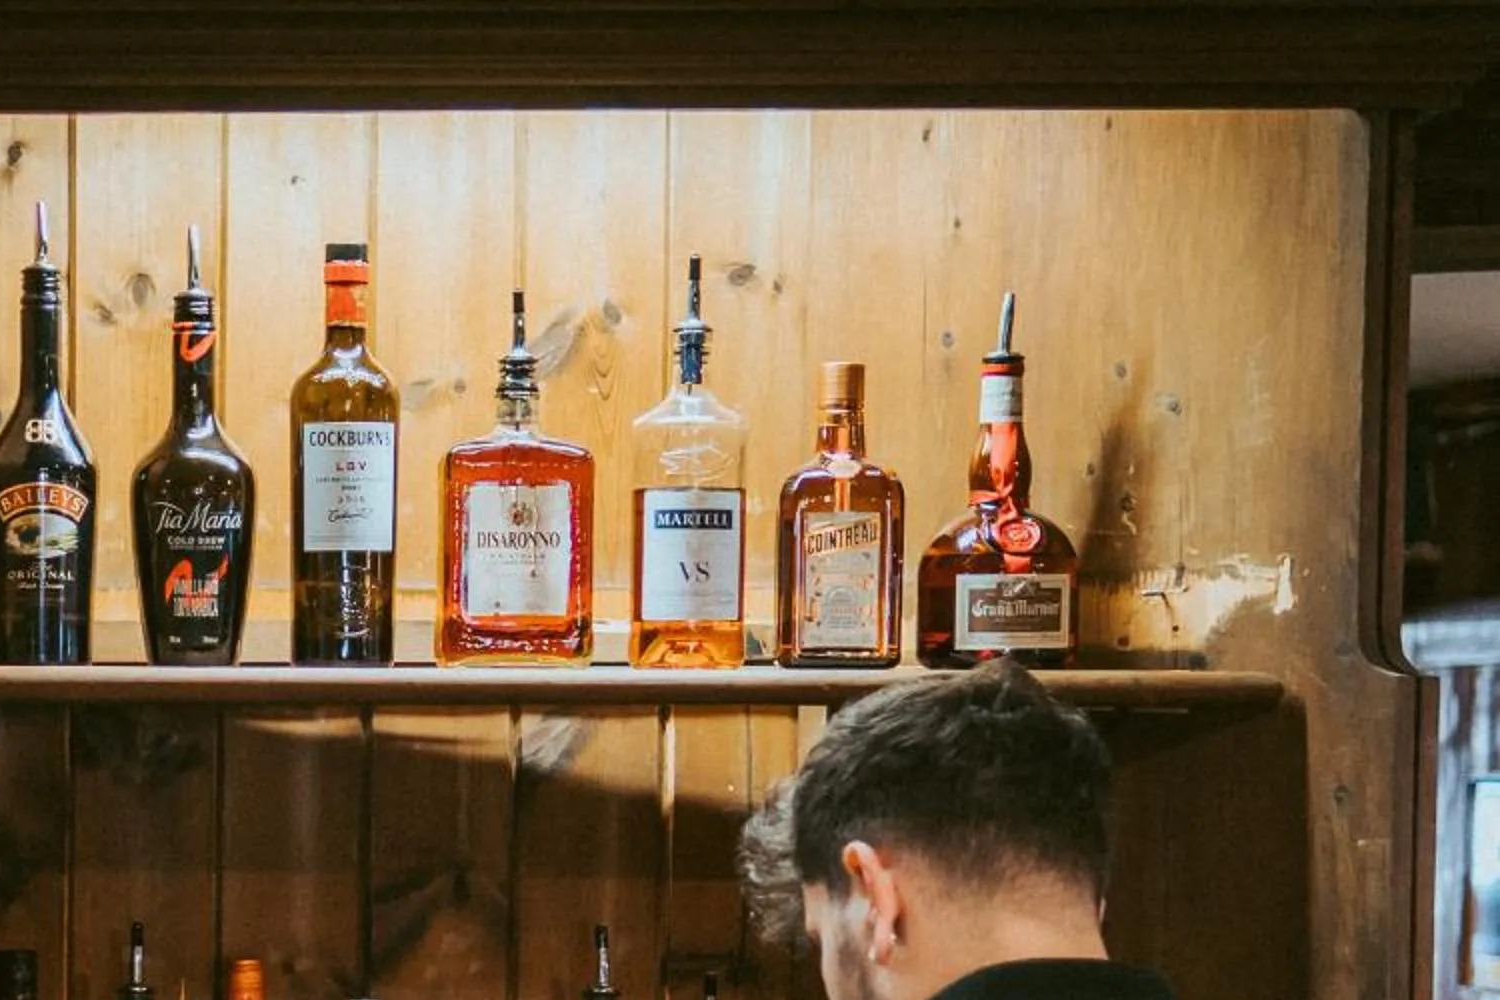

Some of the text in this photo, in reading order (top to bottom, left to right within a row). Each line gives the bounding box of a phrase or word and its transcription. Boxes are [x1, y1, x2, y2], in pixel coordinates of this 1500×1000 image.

[0, 486, 81, 512] BAILEYS
[150, 500, 243, 534] Tia Maria
[657, 512, 730, 527] MARTELL
[477, 531, 561, 550] DISARONNO
[807, 519, 878, 555] COINTREAU
[678, 560, 711, 583] VS
